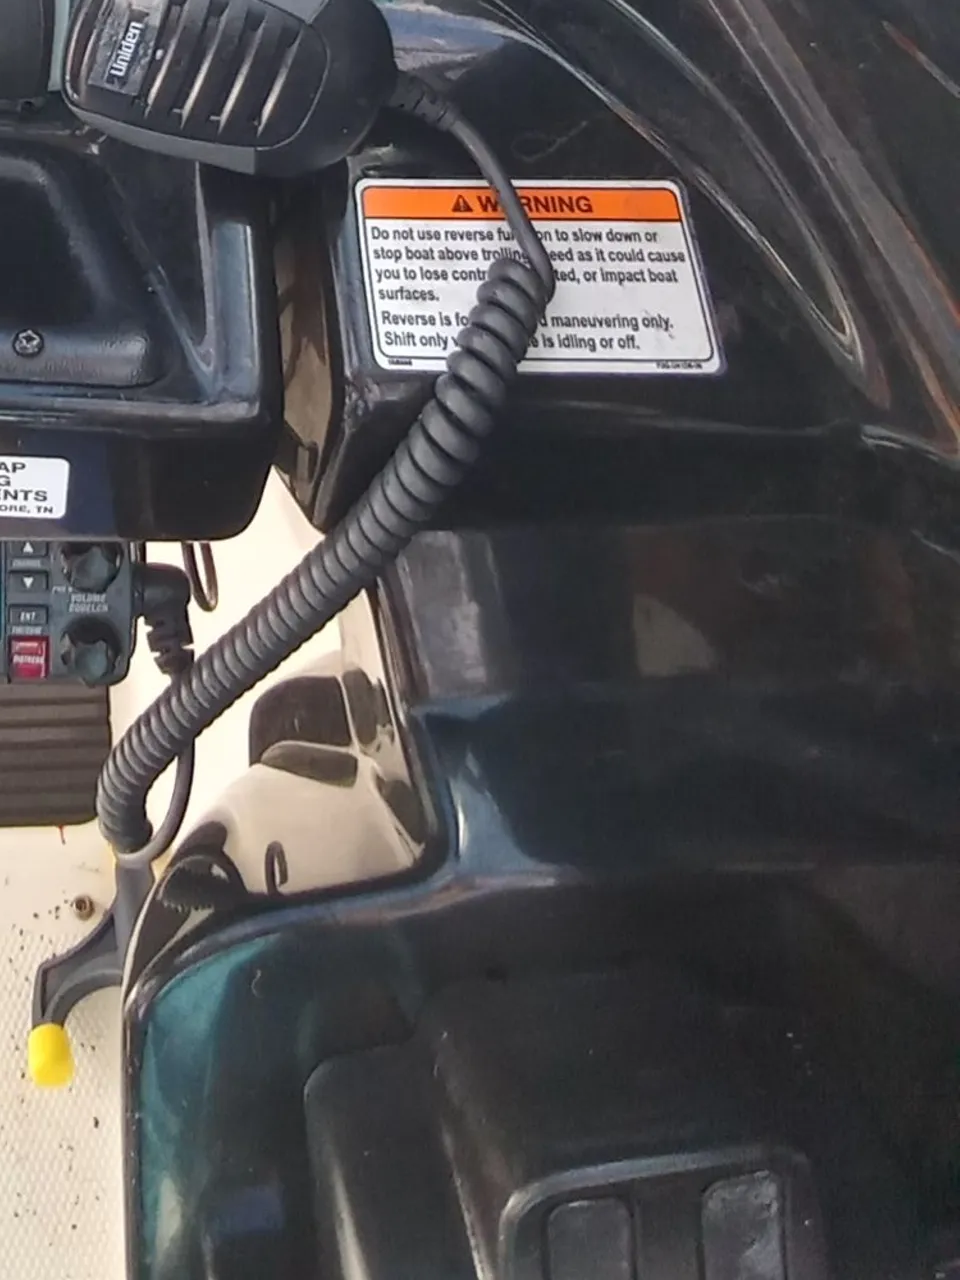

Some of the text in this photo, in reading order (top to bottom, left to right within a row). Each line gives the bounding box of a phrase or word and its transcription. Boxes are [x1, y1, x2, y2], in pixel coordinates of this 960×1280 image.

[110, 22, 143, 76] Uniden
[476, 195, 594, 214] WRNING
[371, 226, 390, 240] Do
[393, 227, 415, 241] not
[418, 230, 441, 241] use
[444, 230, 494, 242] reverse
[555, 229, 569, 242] to
[572, 228, 602, 242] slow
[606, 228, 642, 243] down
[645, 232, 658, 243] or
[373, 247, 402, 263] stop
[406, 246, 435, 260] boat
[437, 247, 479, 261] above
[577, 250, 593, 262] as
[595, 248, 606, 262] it
[608, 248, 645, 263] could
[647, 251, 686, 263] cause
[375, 268, 401, 284] you
[403, 267, 417, 280] to
[420, 266, 449, 281] lose
[583, 272, 598, 283] or
[602, 269, 647, 286] impact
[649, 269, 679, 283] boat
[378, 286, 441, 302] surfaces.
[381, 310, 436, 327] Reverse
[439, 312, 452, 327] is
[454, 312, 470, 327] fo
[551, 314, 640, 331] maneuvering
[641, 314, 675, 332] only.
[384, 331, 417, 347] Shift
[419, 332, 449, 351] only
[542, 333, 555, 349] is
[557, 333, 597, 352] idling
[599, 336, 615, 349] or
[617, 334, 641, 350] off.
[35, 505, 54, 515] TN
